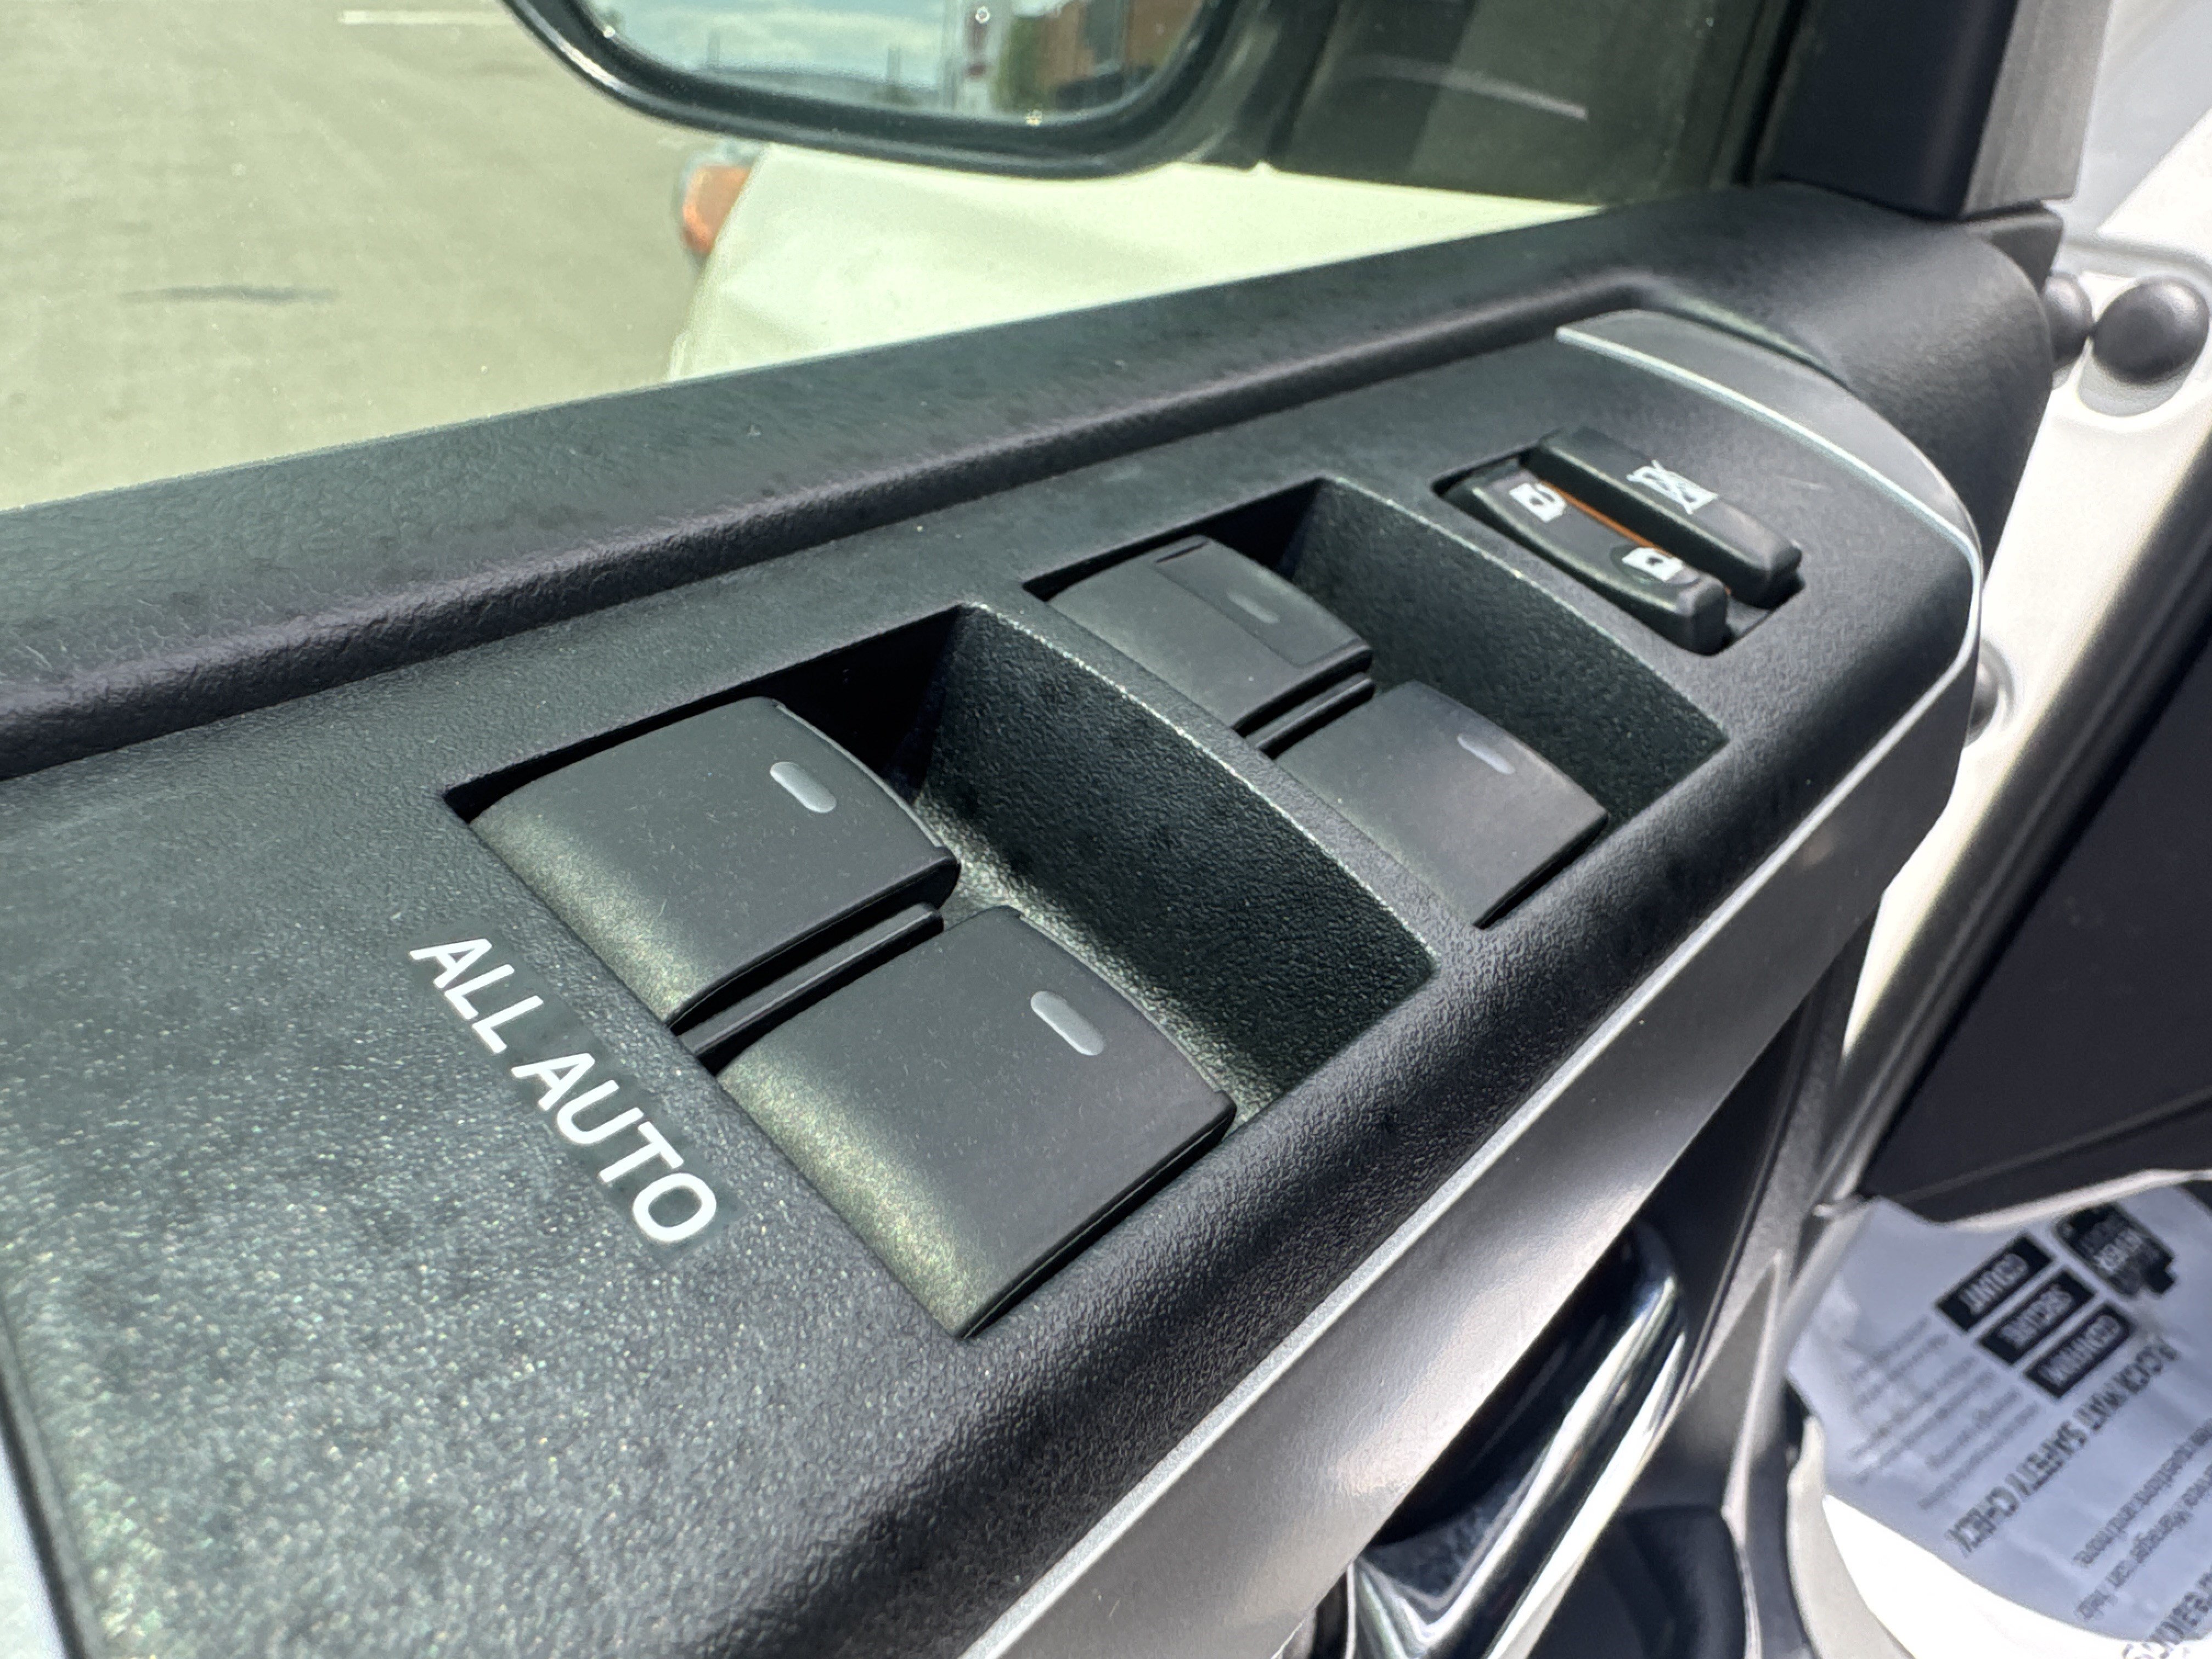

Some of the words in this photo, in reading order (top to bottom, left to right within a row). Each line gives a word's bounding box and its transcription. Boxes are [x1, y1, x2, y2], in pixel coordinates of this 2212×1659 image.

[409, 938, 544, 1053] ALL
[510, 1052, 717, 1243] AUTO
[1957, 1252, 2032, 1319] COUNT
[1995, 1283, 2076, 1352] SECURE
[2003, 1419, 2090, 1503] SAFETY
